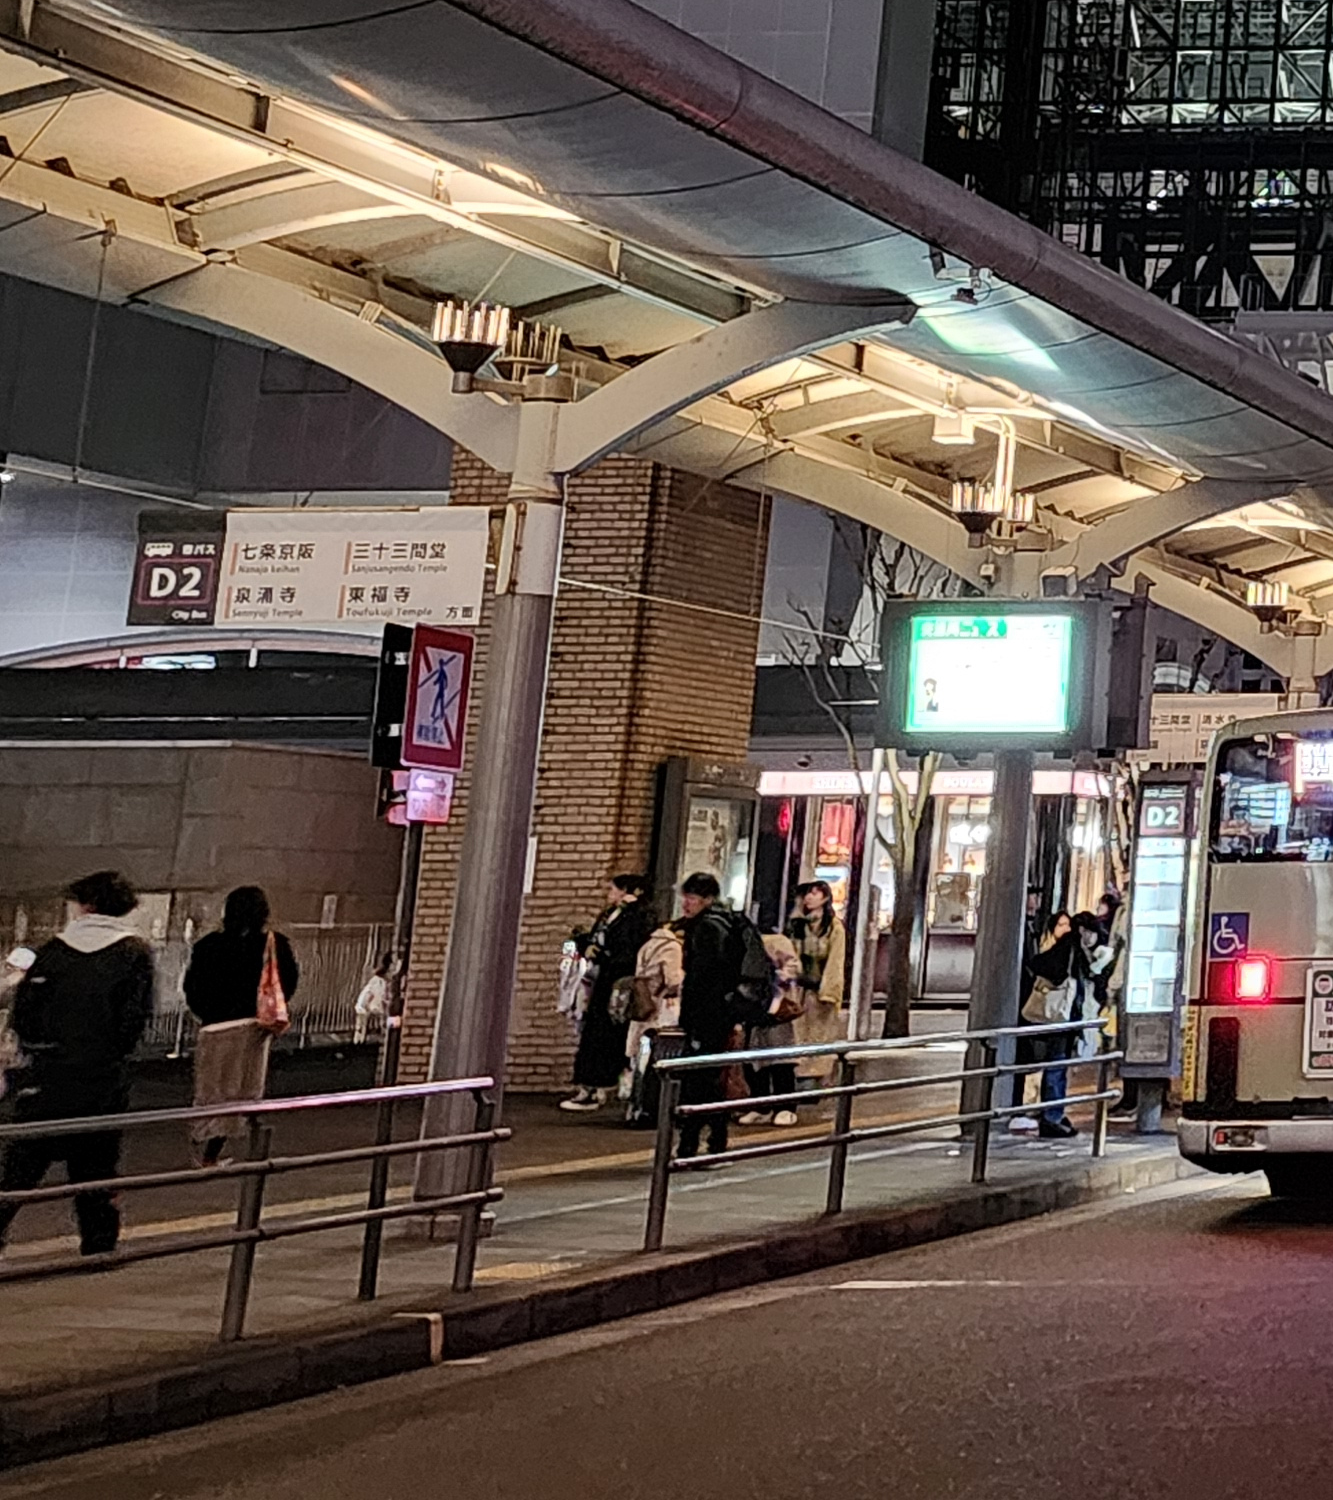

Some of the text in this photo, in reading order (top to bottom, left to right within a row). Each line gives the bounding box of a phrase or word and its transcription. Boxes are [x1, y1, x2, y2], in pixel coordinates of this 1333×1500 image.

[241, 543, 316, 560] 七条京阪
[149, 566, 202, 598] D2
[348, 586, 411, 603] 東福寺
[445, 606, 475, 619] 方面
[1146, 806, 1180, 827] D2
